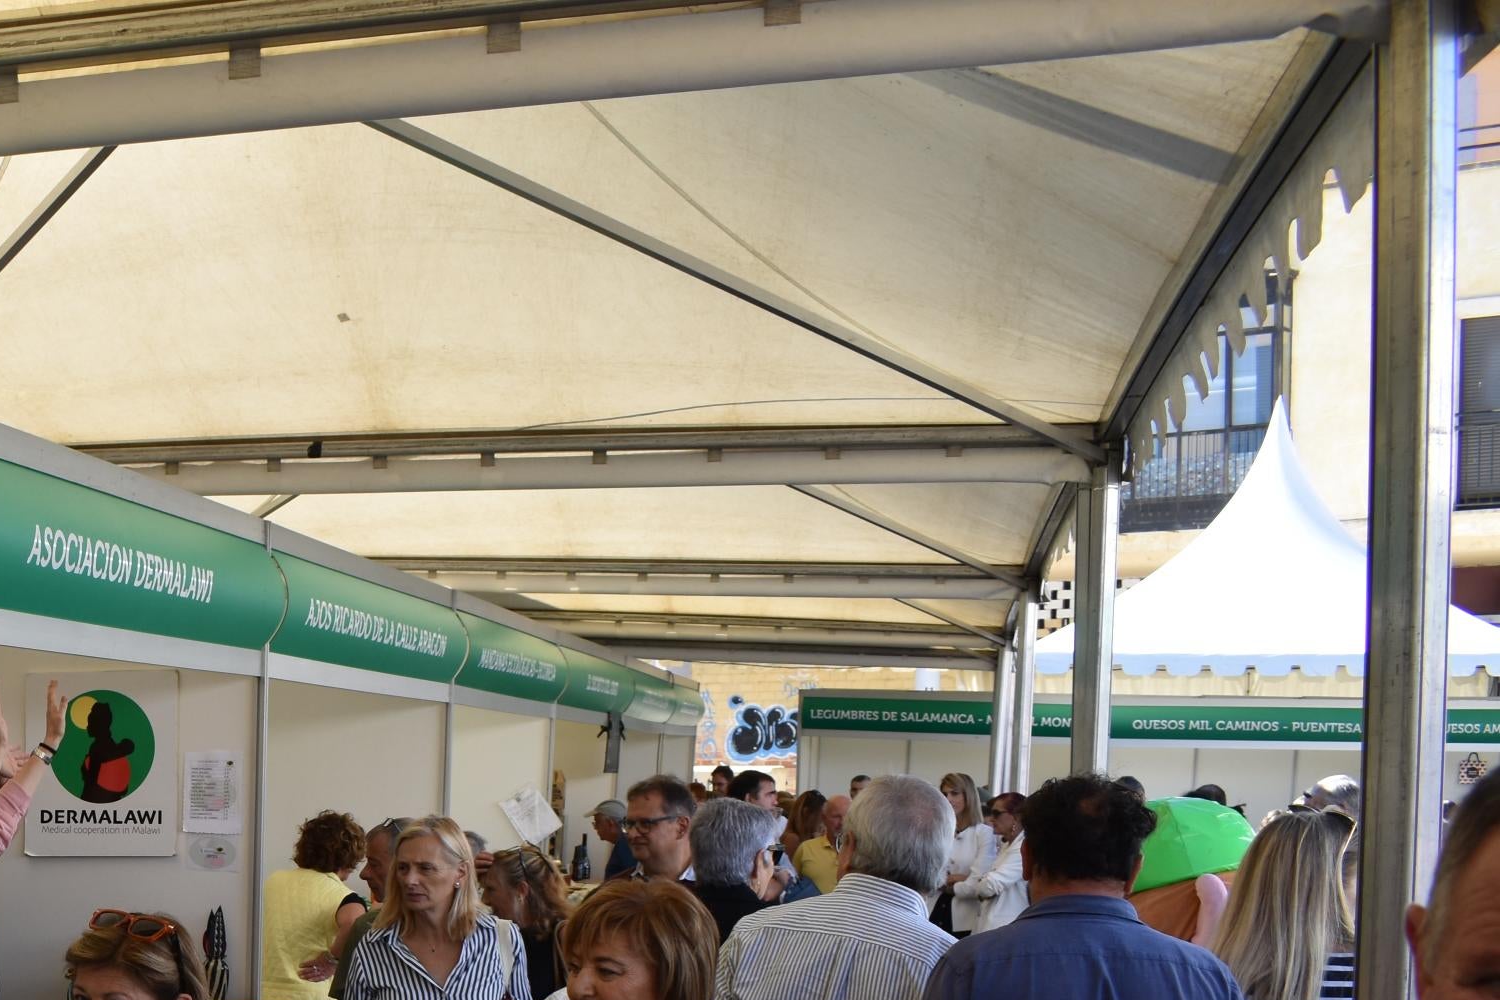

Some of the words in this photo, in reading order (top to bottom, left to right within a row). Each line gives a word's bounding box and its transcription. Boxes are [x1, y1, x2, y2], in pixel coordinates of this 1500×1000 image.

[26, 524, 133, 585] ASOCIACION
[133, 550, 214, 604] DERMALAWI
[304, 598, 333, 631] AJOS
[331, 604, 373, 640] RICARDO
[371, 615, 384, 644] DE
[383, 618, 396, 646] LA
[394, 622, 419, 652] CALLE
[416, 627, 448, 658] ARAGÓN
[810, 708, 879, 721] LEGUMBRES
[882, 711, 898, 721] DE
[900, 711, 975, 724] SALAMANCA
[1132, 719, 1186, 730] QUESOS
[1188, 719, 1213, 731] MIL
[1215, 720, 1280, 732] CAMINOS
[40, 809, 163, 825] DERMALAWI
[41, 825, 72, 834] Medical
[73, 825, 120, 836] cooperation
[122, 826, 130, 834] in
[131, 825, 161, 835] Malawi
